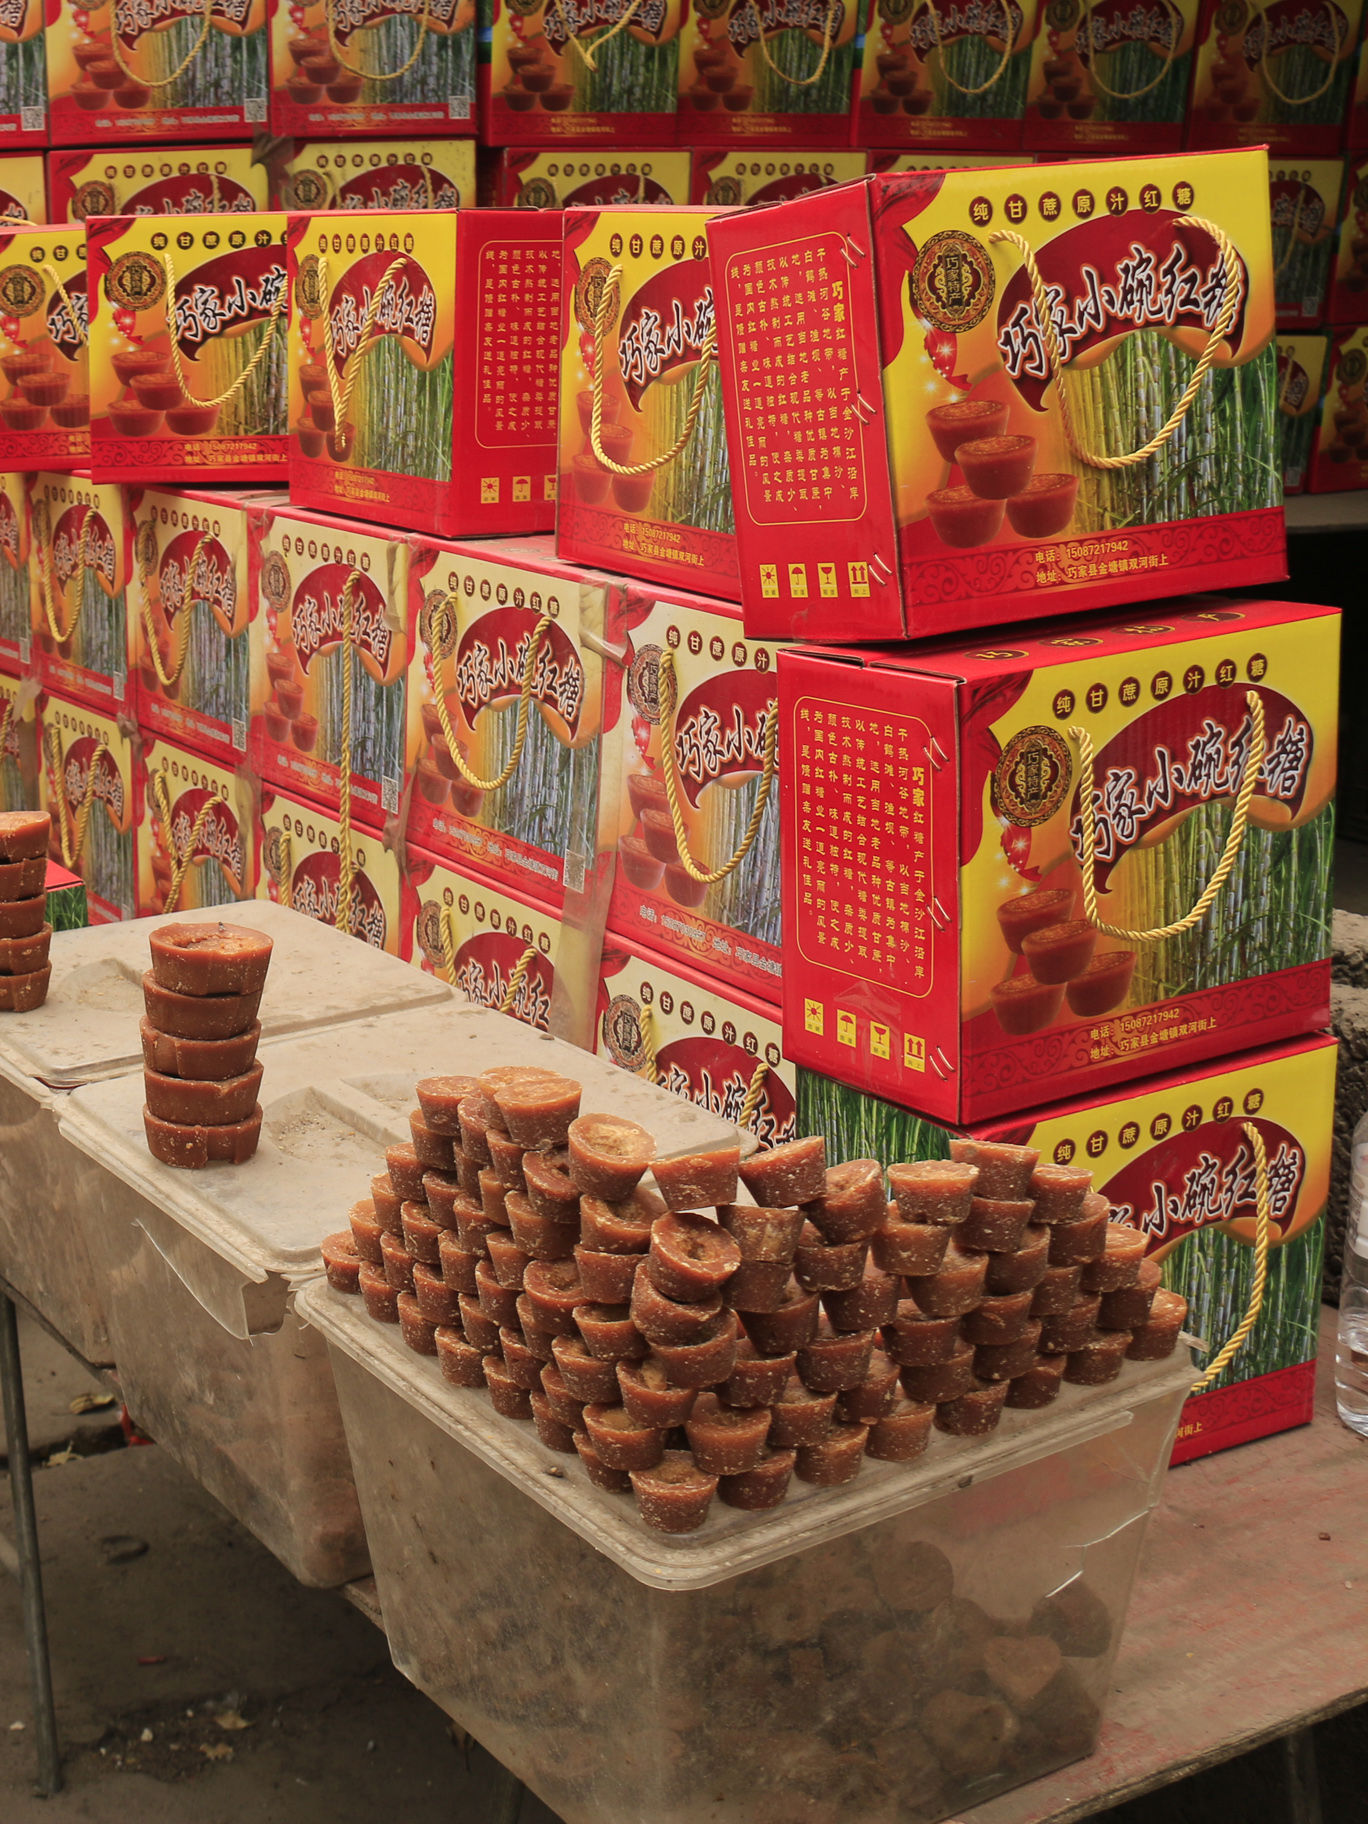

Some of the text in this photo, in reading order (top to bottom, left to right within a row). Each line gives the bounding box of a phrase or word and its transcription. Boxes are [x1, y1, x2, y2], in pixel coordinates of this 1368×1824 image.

[970, 183, 1195, 224] 纯甘蔗原汁红糖
[611, 237, 705, 257] 纯甘蔗原汁
[1066, 540, 1129, 559] 15087217942
[1067, 553, 1169, 579] 巧家县金塘镇双河街上
[665, 626, 772, 671] 纯甘蔗原汁
[1053, 655, 1269, 717] 纯甘蔗原汁红糖
[1067, 716, 1315, 864] 巧家小碗红糖
[639, 981, 782, 1066] 纯甘蔗原汁红糖
[1120, 1008, 1180, 1032] 15087217942
[1120, 1016, 1217, 1052] 巧家县金塘镇双河街上
[1054, 1088, 1265, 1165] 纯甘蔗原汁红糖
